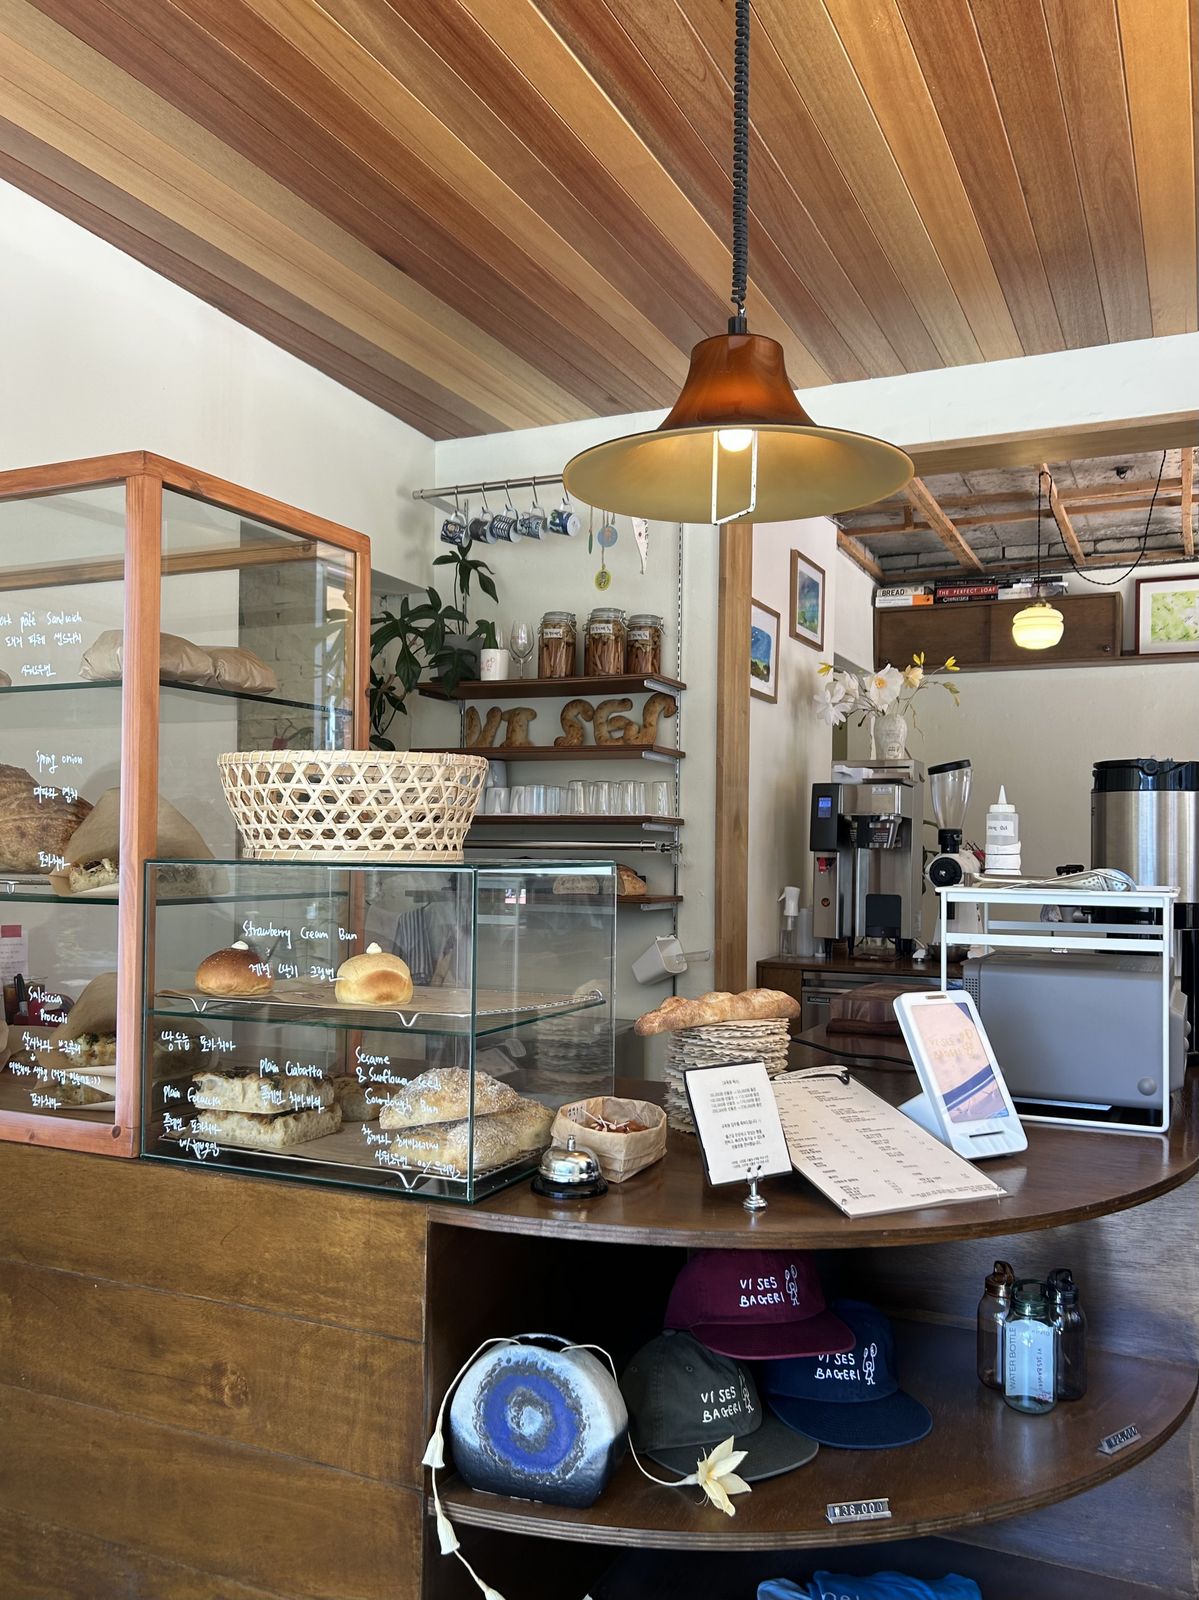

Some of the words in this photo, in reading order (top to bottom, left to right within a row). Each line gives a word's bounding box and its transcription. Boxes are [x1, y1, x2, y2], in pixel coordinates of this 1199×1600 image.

[881, 588, 905, 597] BREAD
[938, 589, 949, 597] THE
[953, 588, 977, 596] PERFECT
[980, 586, 996, 594] LOAF
[61, 753, 83, 765] onion
[242, 920, 292, 950] Strawberry
[300, 926, 329, 940] Cream
[338, 927, 358, 940] Bun
[278, 963, 299, 978] 딸기
[310, 965, 345, 982] 크림번
[200, 1034, 236, 1052] 포카치아
[355, 1045, 391, 1065] Sesame
[285, 1060, 323, 1080] Ciabatta
[355, 1066, 367, 1083] &
[739, 1278, 752, 1290] VI
[756, 1276, 778, 1290] SES
[739, 1291, 785, 1308] BAGERI
[1009, 1327, 1017, 1359] BOTTLE
[833, 1353, 856, 1366] SES
[814, 1367, 861, 1381] BAGERI
[1009, 1360, 1017, 1391] WATER
[700, 1390, 714, 1404] VI
[718, 1386, 737, 1403] SES
[702, 1403, 742, 1423] BAGERI
